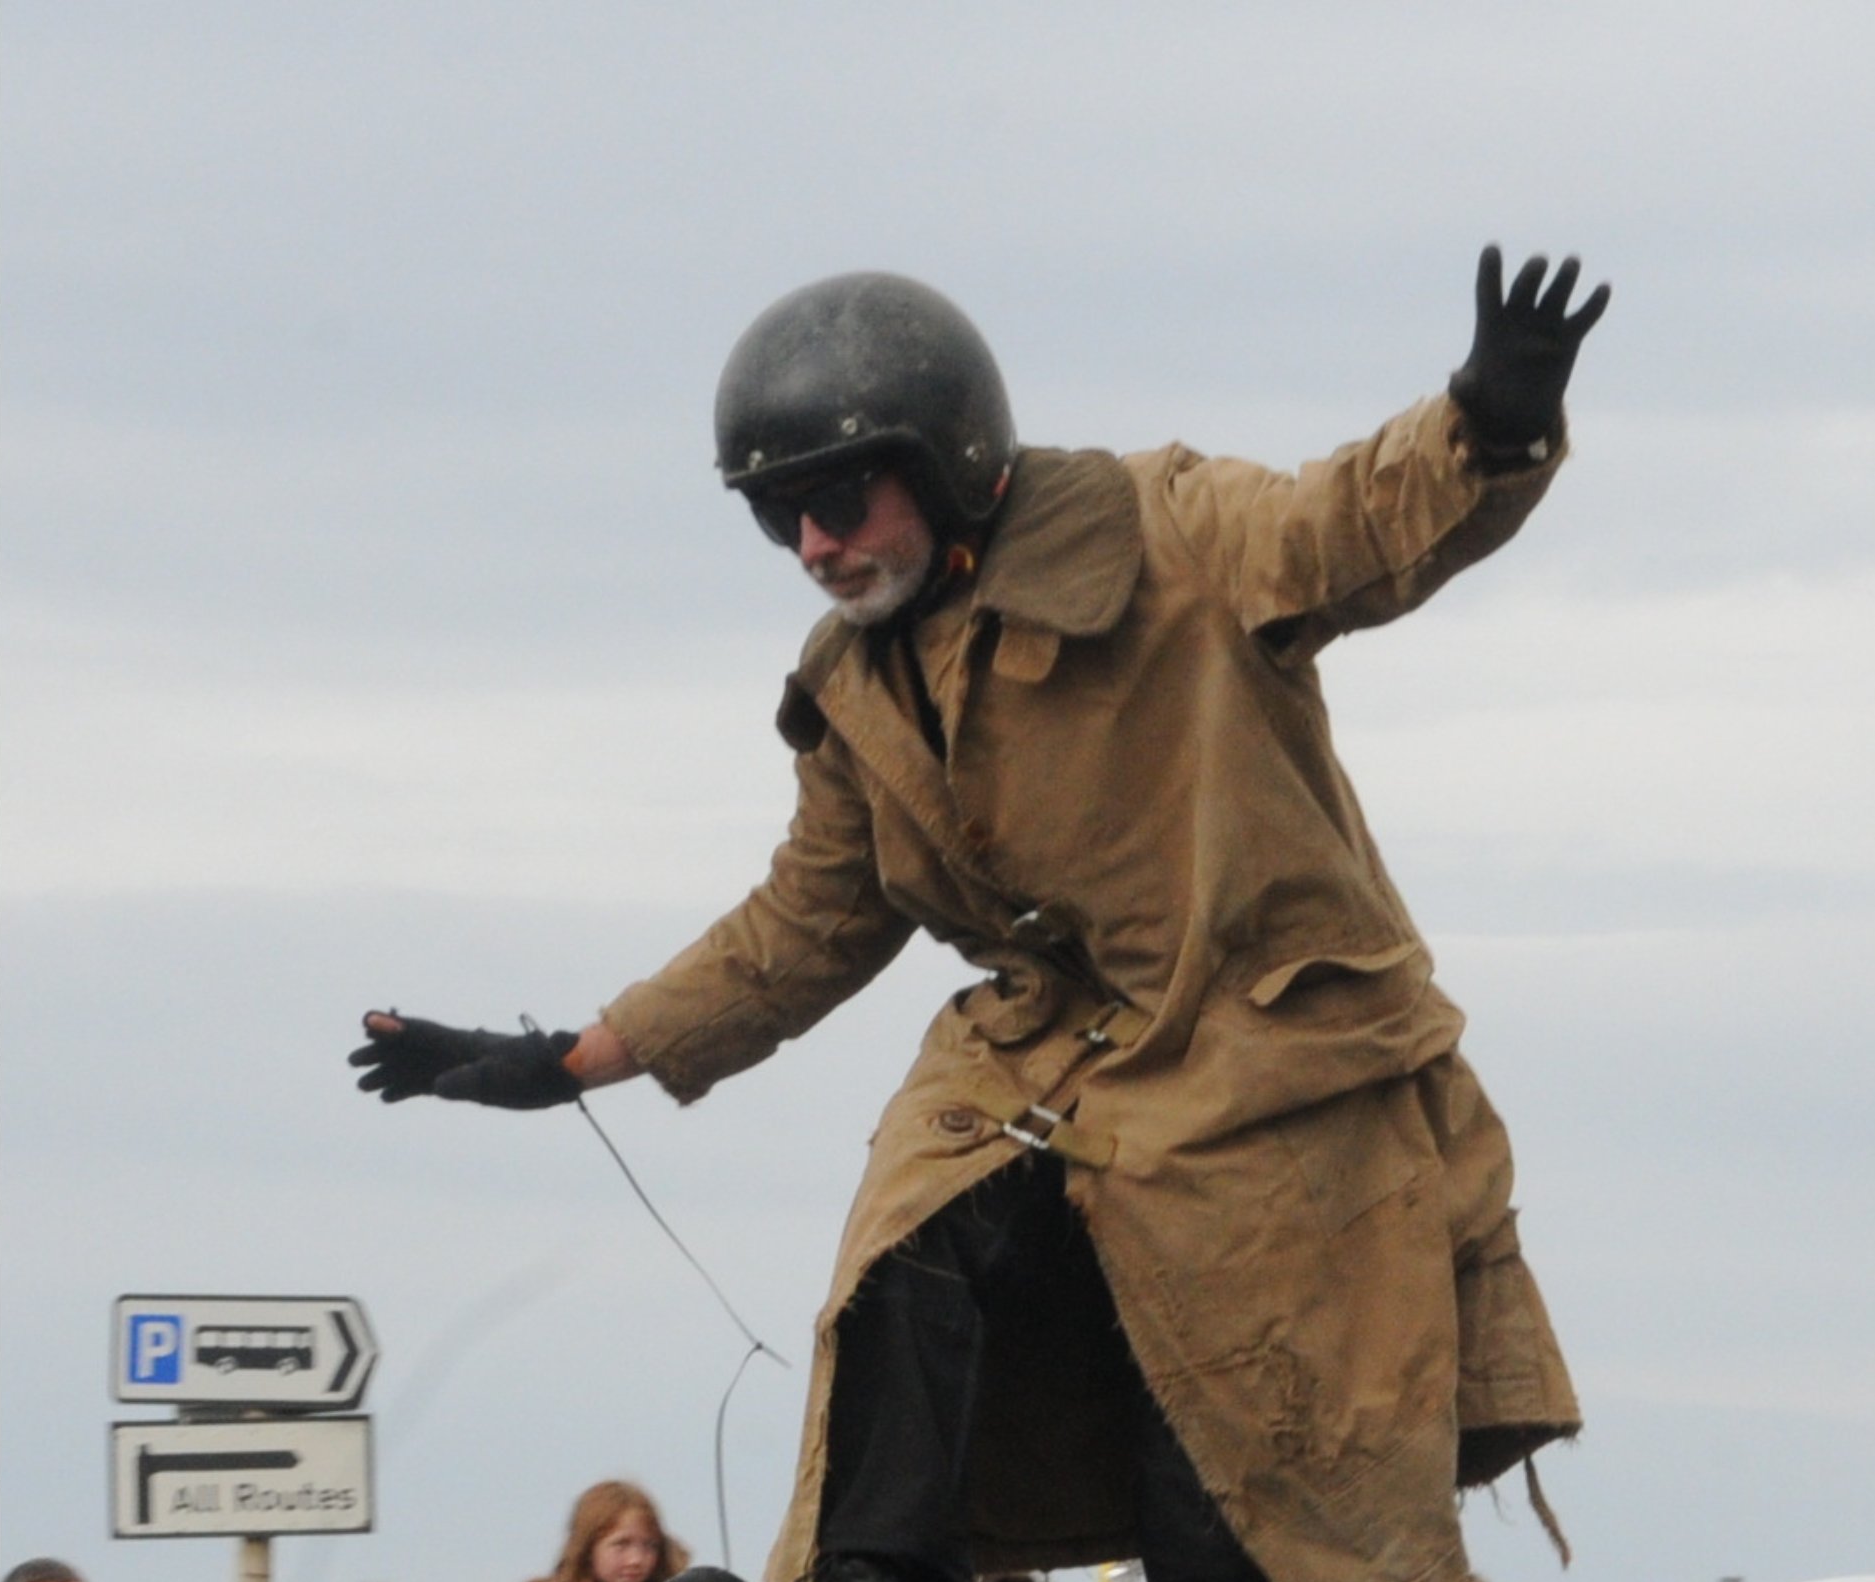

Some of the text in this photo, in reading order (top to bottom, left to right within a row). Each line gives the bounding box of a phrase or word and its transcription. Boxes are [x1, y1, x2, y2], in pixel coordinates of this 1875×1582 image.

[137, 1321, 176, 1378] P
[171, 1483, 356, 1513] All Routes
